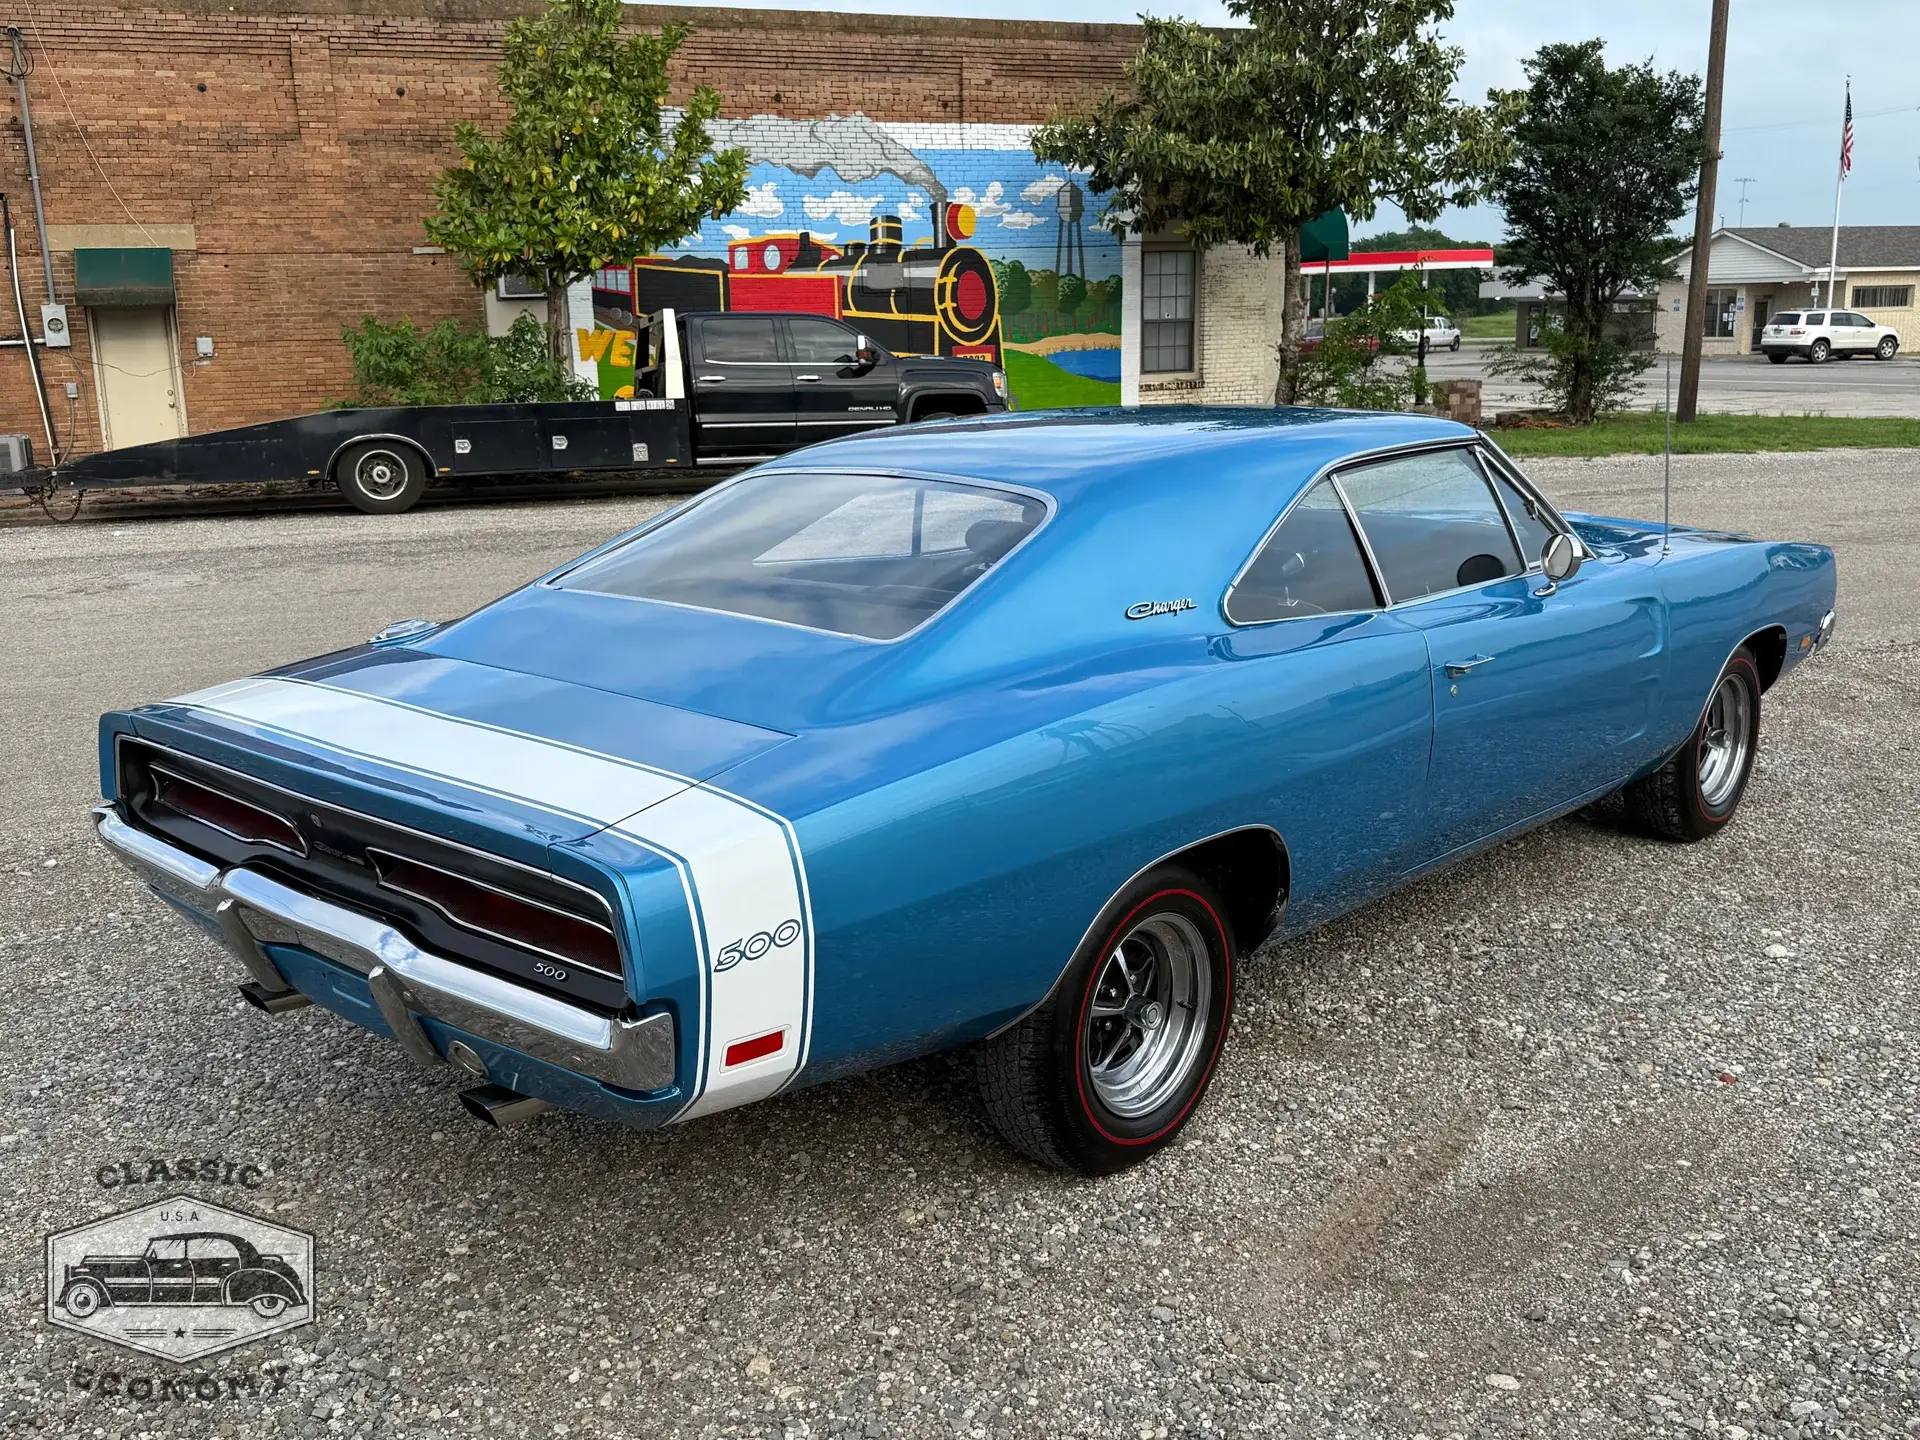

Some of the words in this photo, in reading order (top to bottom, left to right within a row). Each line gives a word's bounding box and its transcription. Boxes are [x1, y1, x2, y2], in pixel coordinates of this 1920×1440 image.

[576, 328, 637, 367] WE
[1125, 598, 1198, 620] Charger
[713, 919, 801, 973] 500
[533, 962, 568, 981] 500
